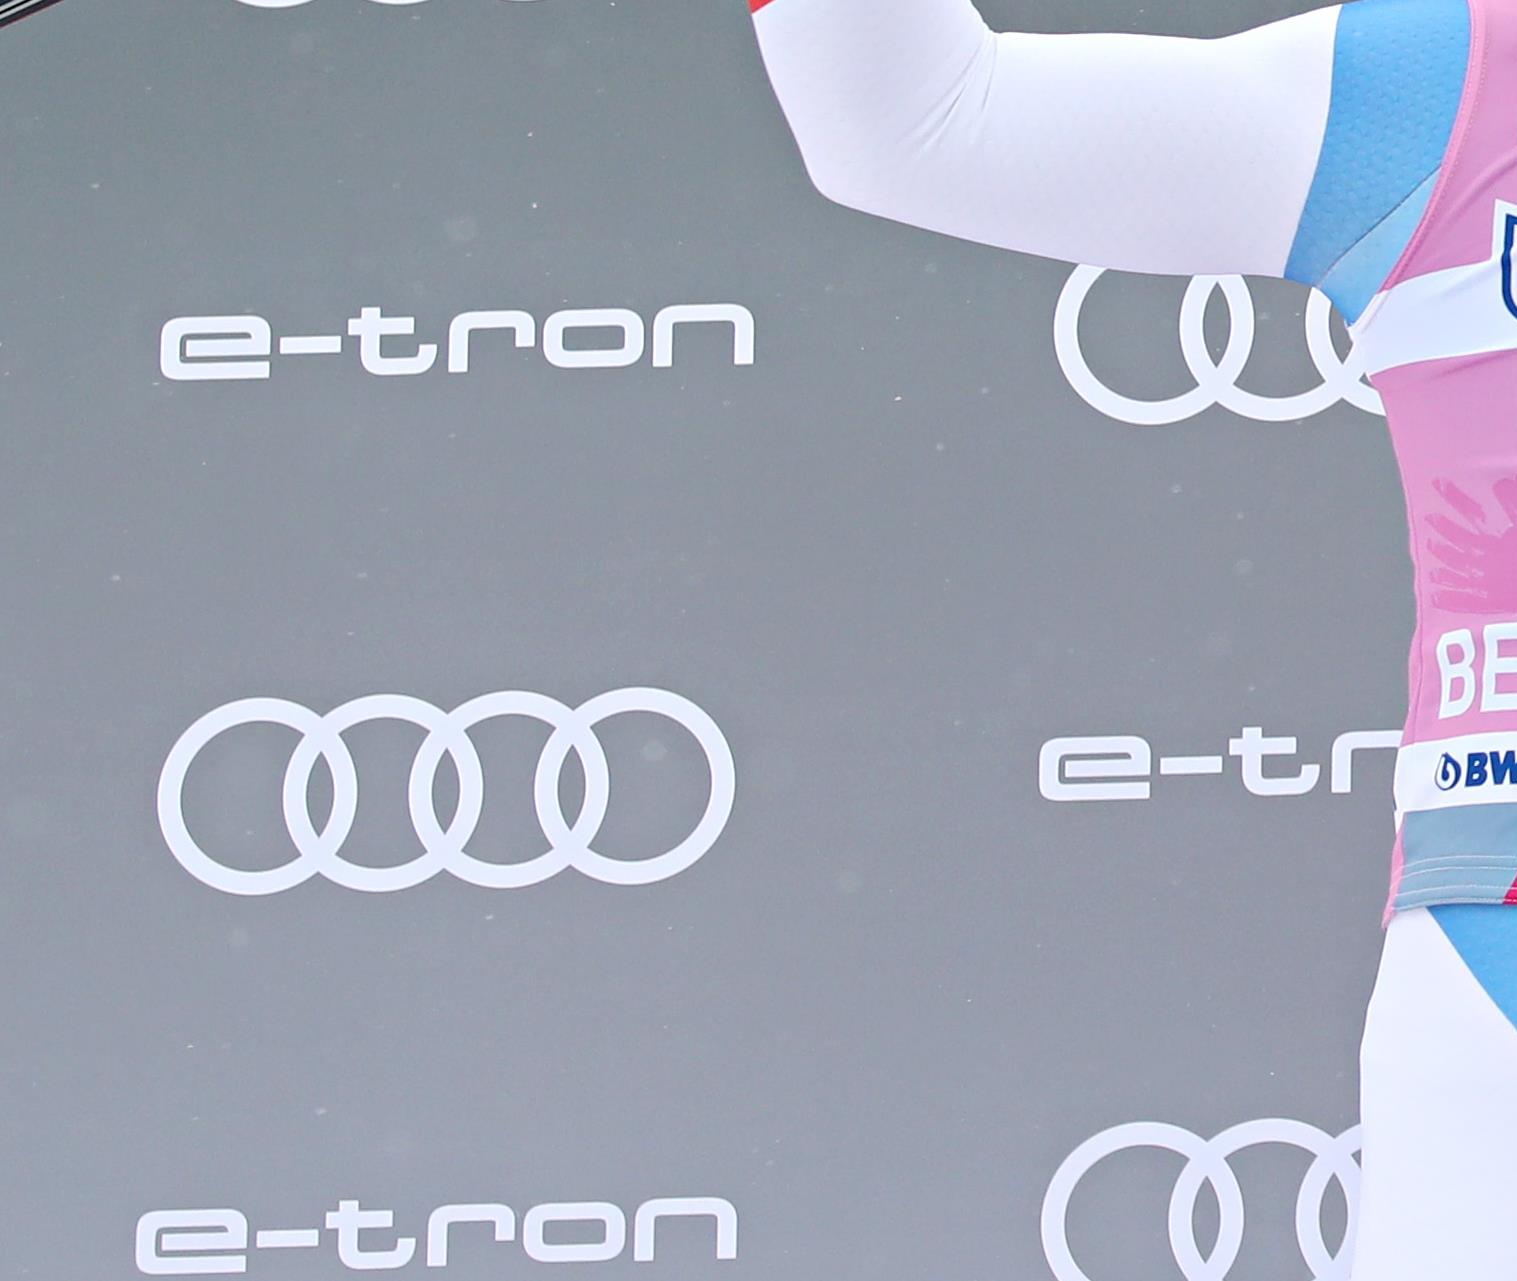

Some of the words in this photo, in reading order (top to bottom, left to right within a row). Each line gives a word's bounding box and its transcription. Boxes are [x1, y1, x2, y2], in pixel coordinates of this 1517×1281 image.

[160, 303, 755, 381] e-tron
[1038, 727, 1409, 802] e-tr
[135, 1197, 738, 1275] e-tron
